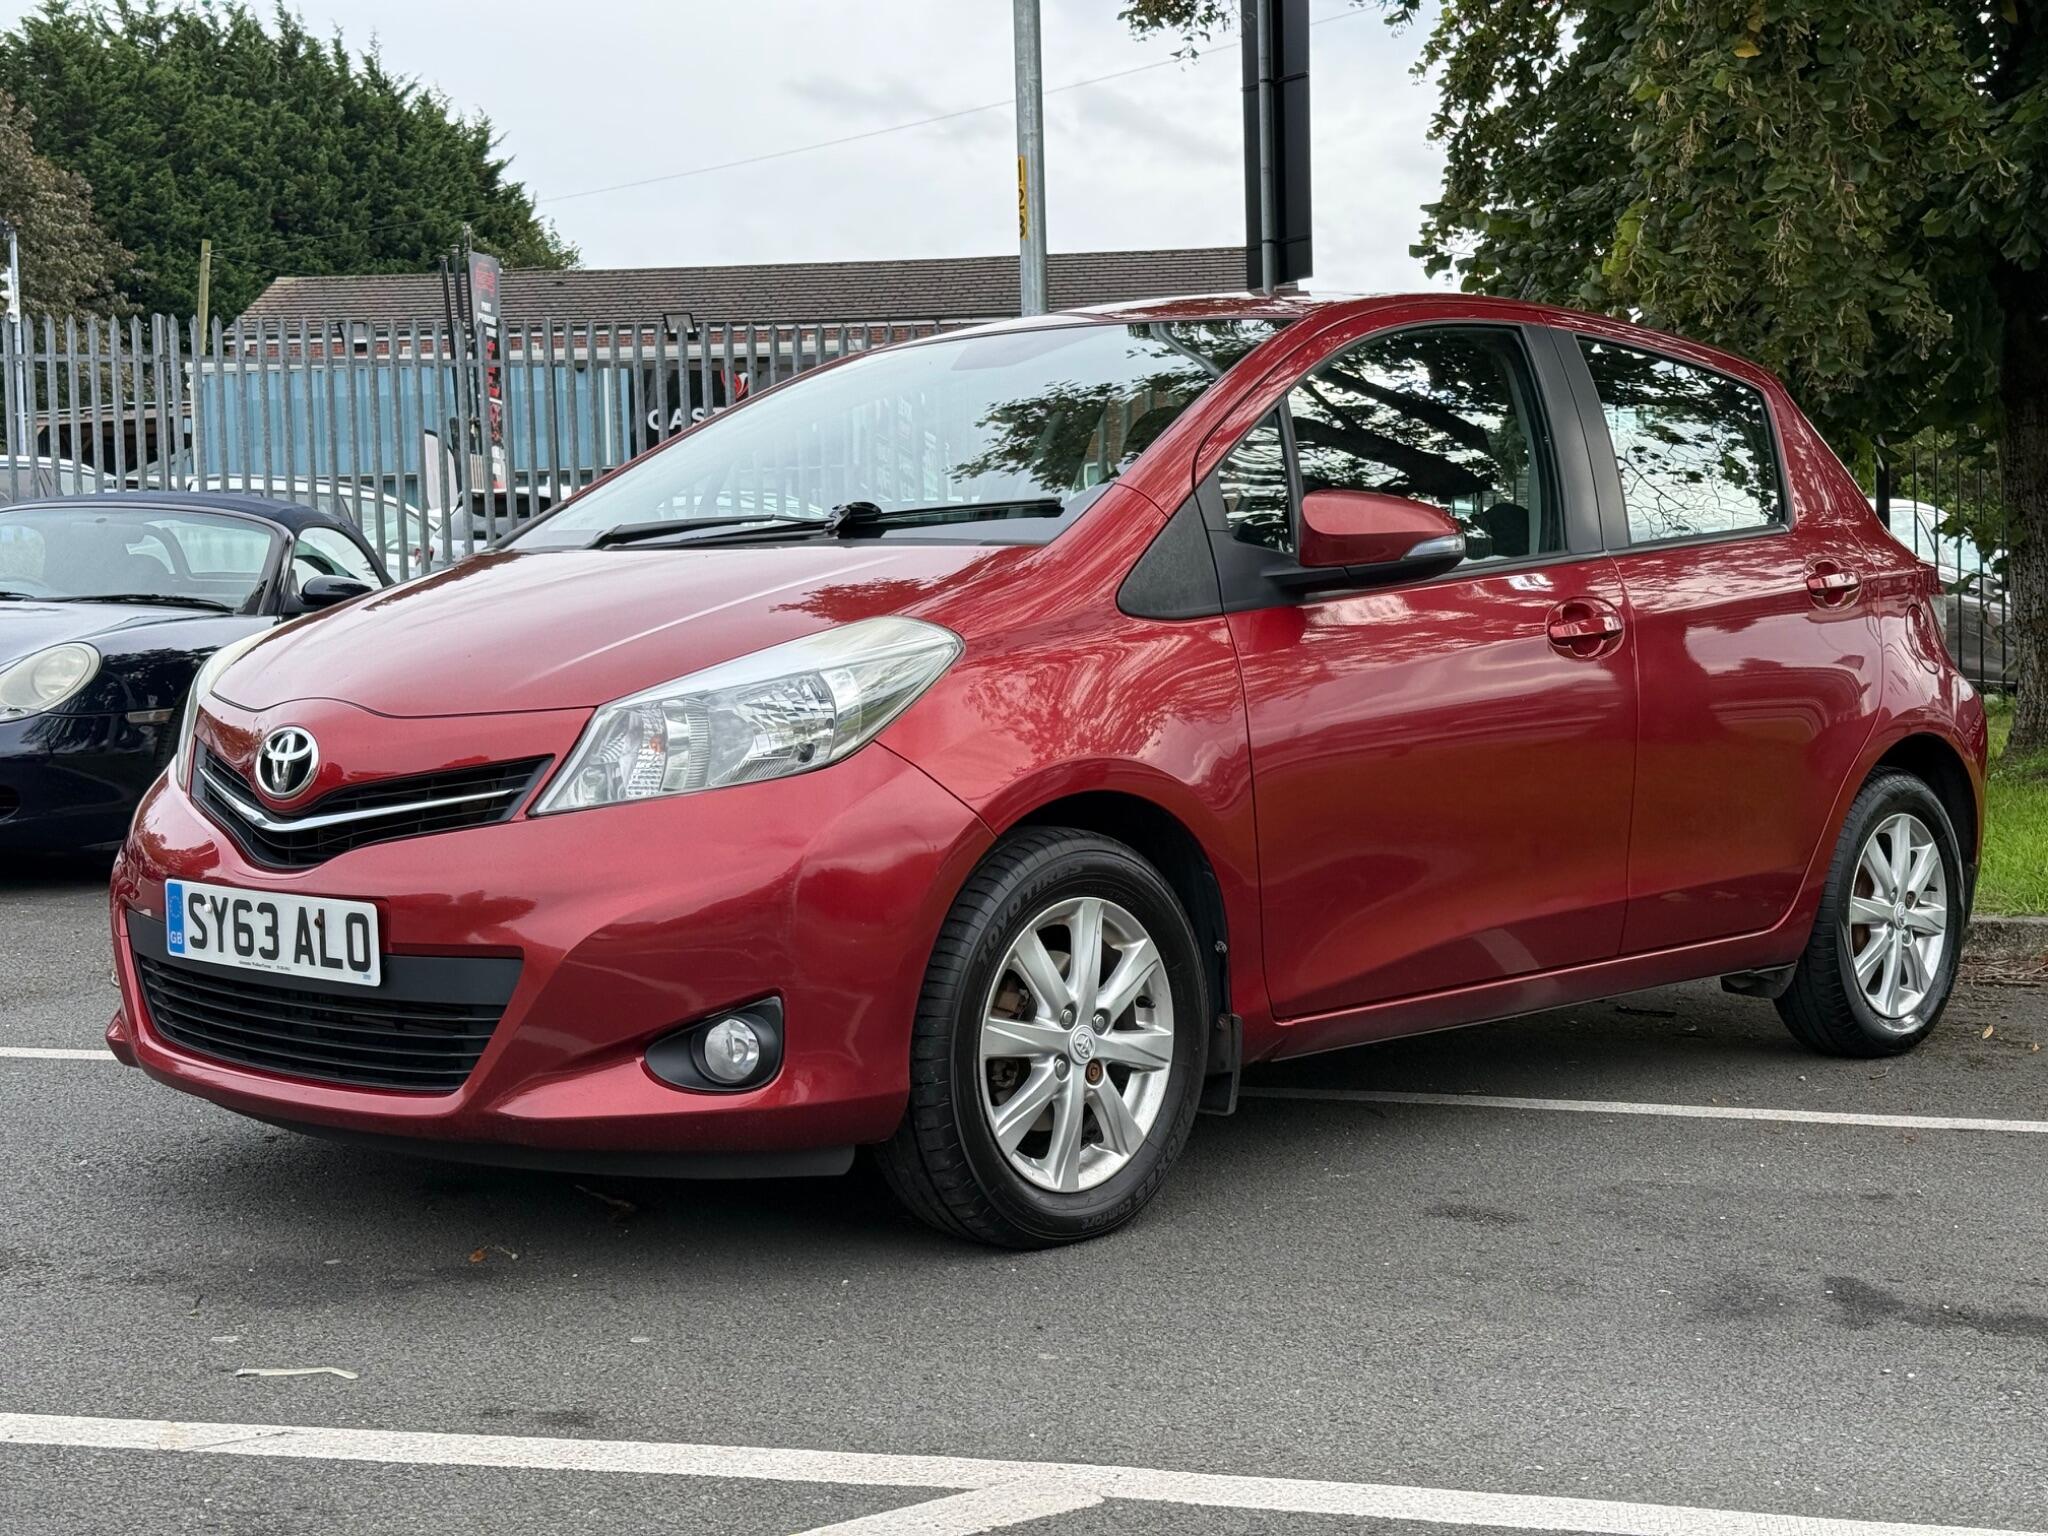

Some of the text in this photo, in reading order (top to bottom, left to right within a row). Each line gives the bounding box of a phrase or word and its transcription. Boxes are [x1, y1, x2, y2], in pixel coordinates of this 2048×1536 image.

[170, 930, 183, 945] GB
[188, 892, 372, 973] SY63 ALO
